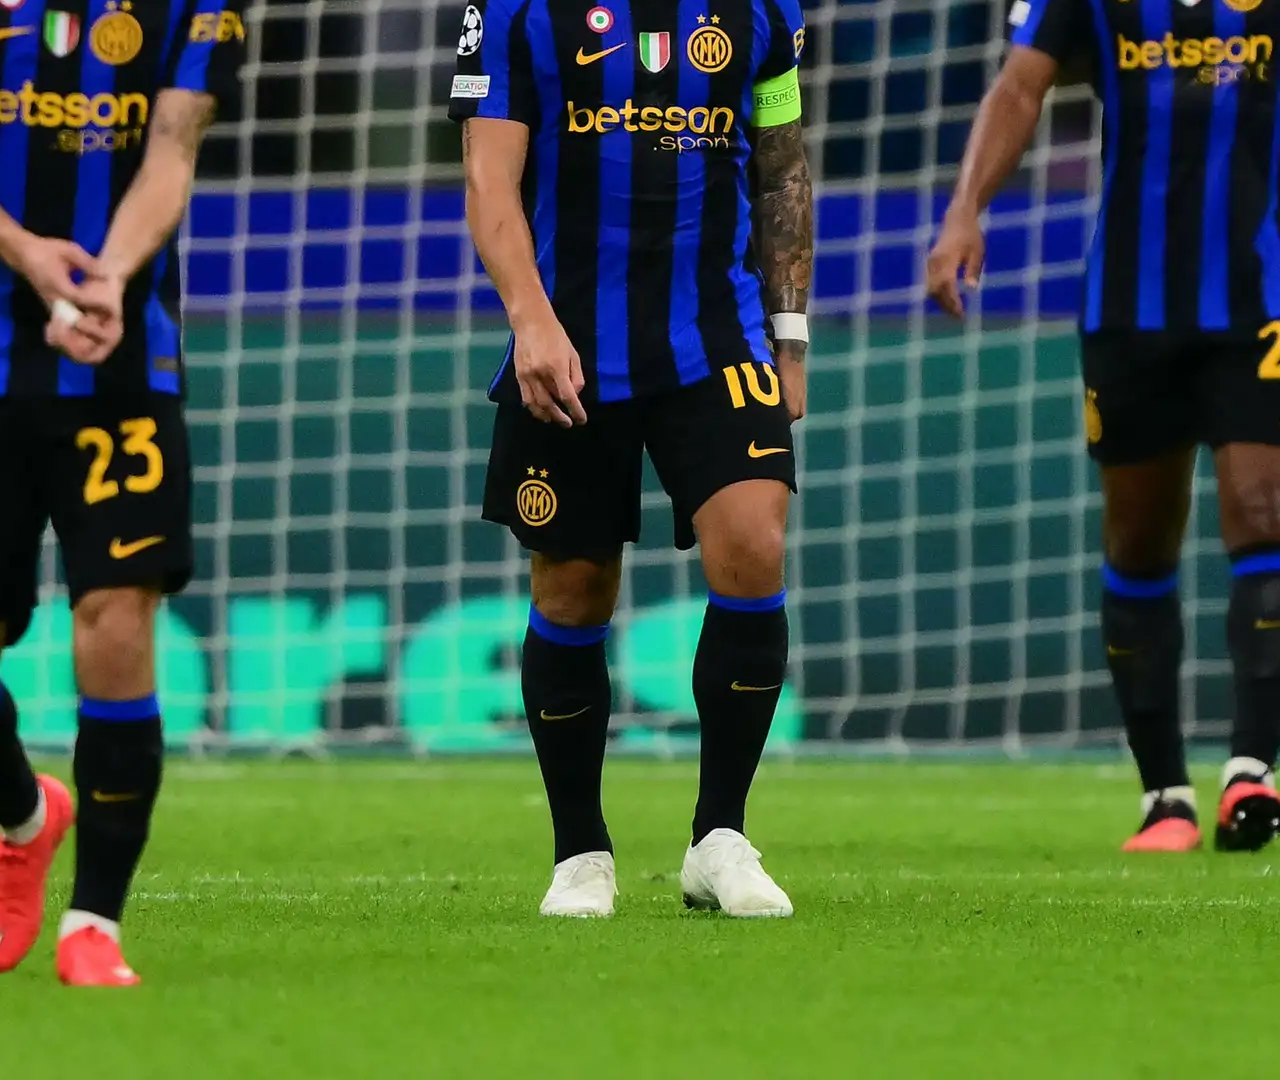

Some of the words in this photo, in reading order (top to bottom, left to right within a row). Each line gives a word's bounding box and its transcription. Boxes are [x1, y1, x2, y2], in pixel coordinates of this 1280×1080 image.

[1117, 32, 1273, 69] betsson
[567, 99, 735, 134] betsson
[653, 133, 730, 155] .sport
[75, 416, 165, 505] 23
